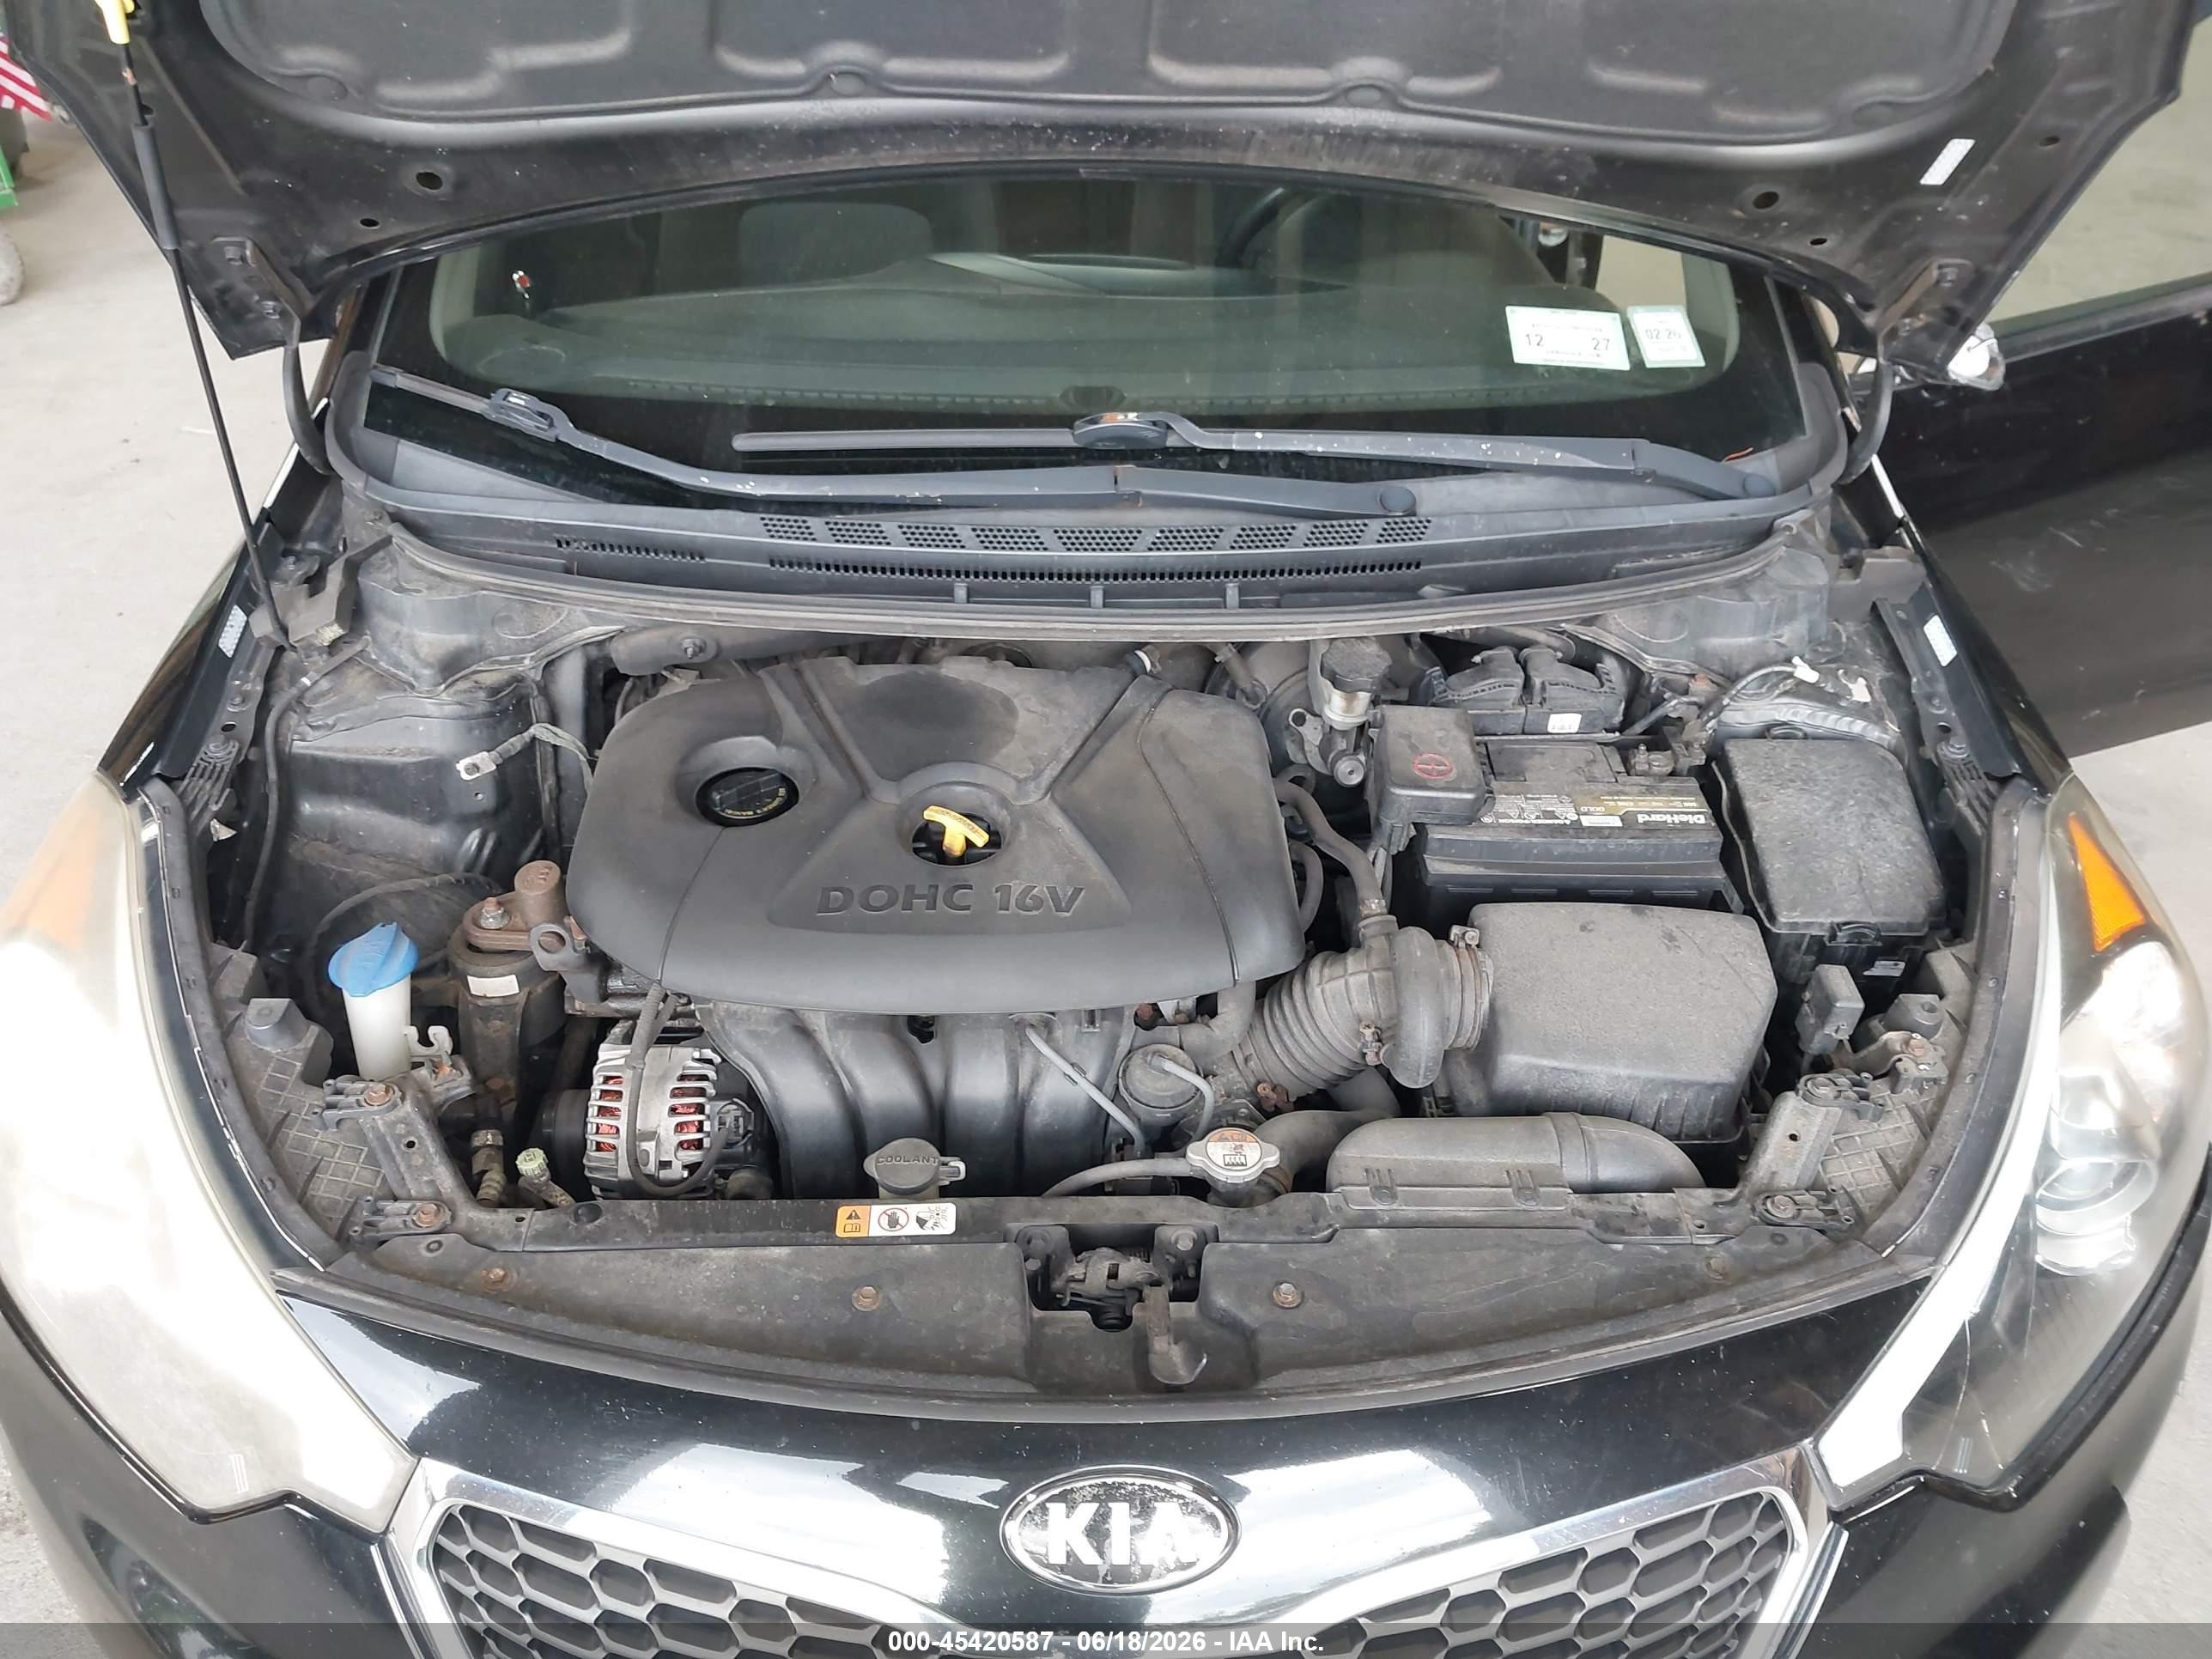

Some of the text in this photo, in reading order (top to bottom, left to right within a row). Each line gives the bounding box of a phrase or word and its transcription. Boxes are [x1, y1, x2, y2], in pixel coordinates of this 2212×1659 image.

[1525, 333, 1545, 347] 12
[1591, 337, 1611, 351] 27
[1637, 813, 1706, 824] DieHard
[817, 883, 1085, 916] DOHC 16V
[876, 1154, 939, 1166] COOLANT
[1046, 1501, 1198, 1566] KIA
